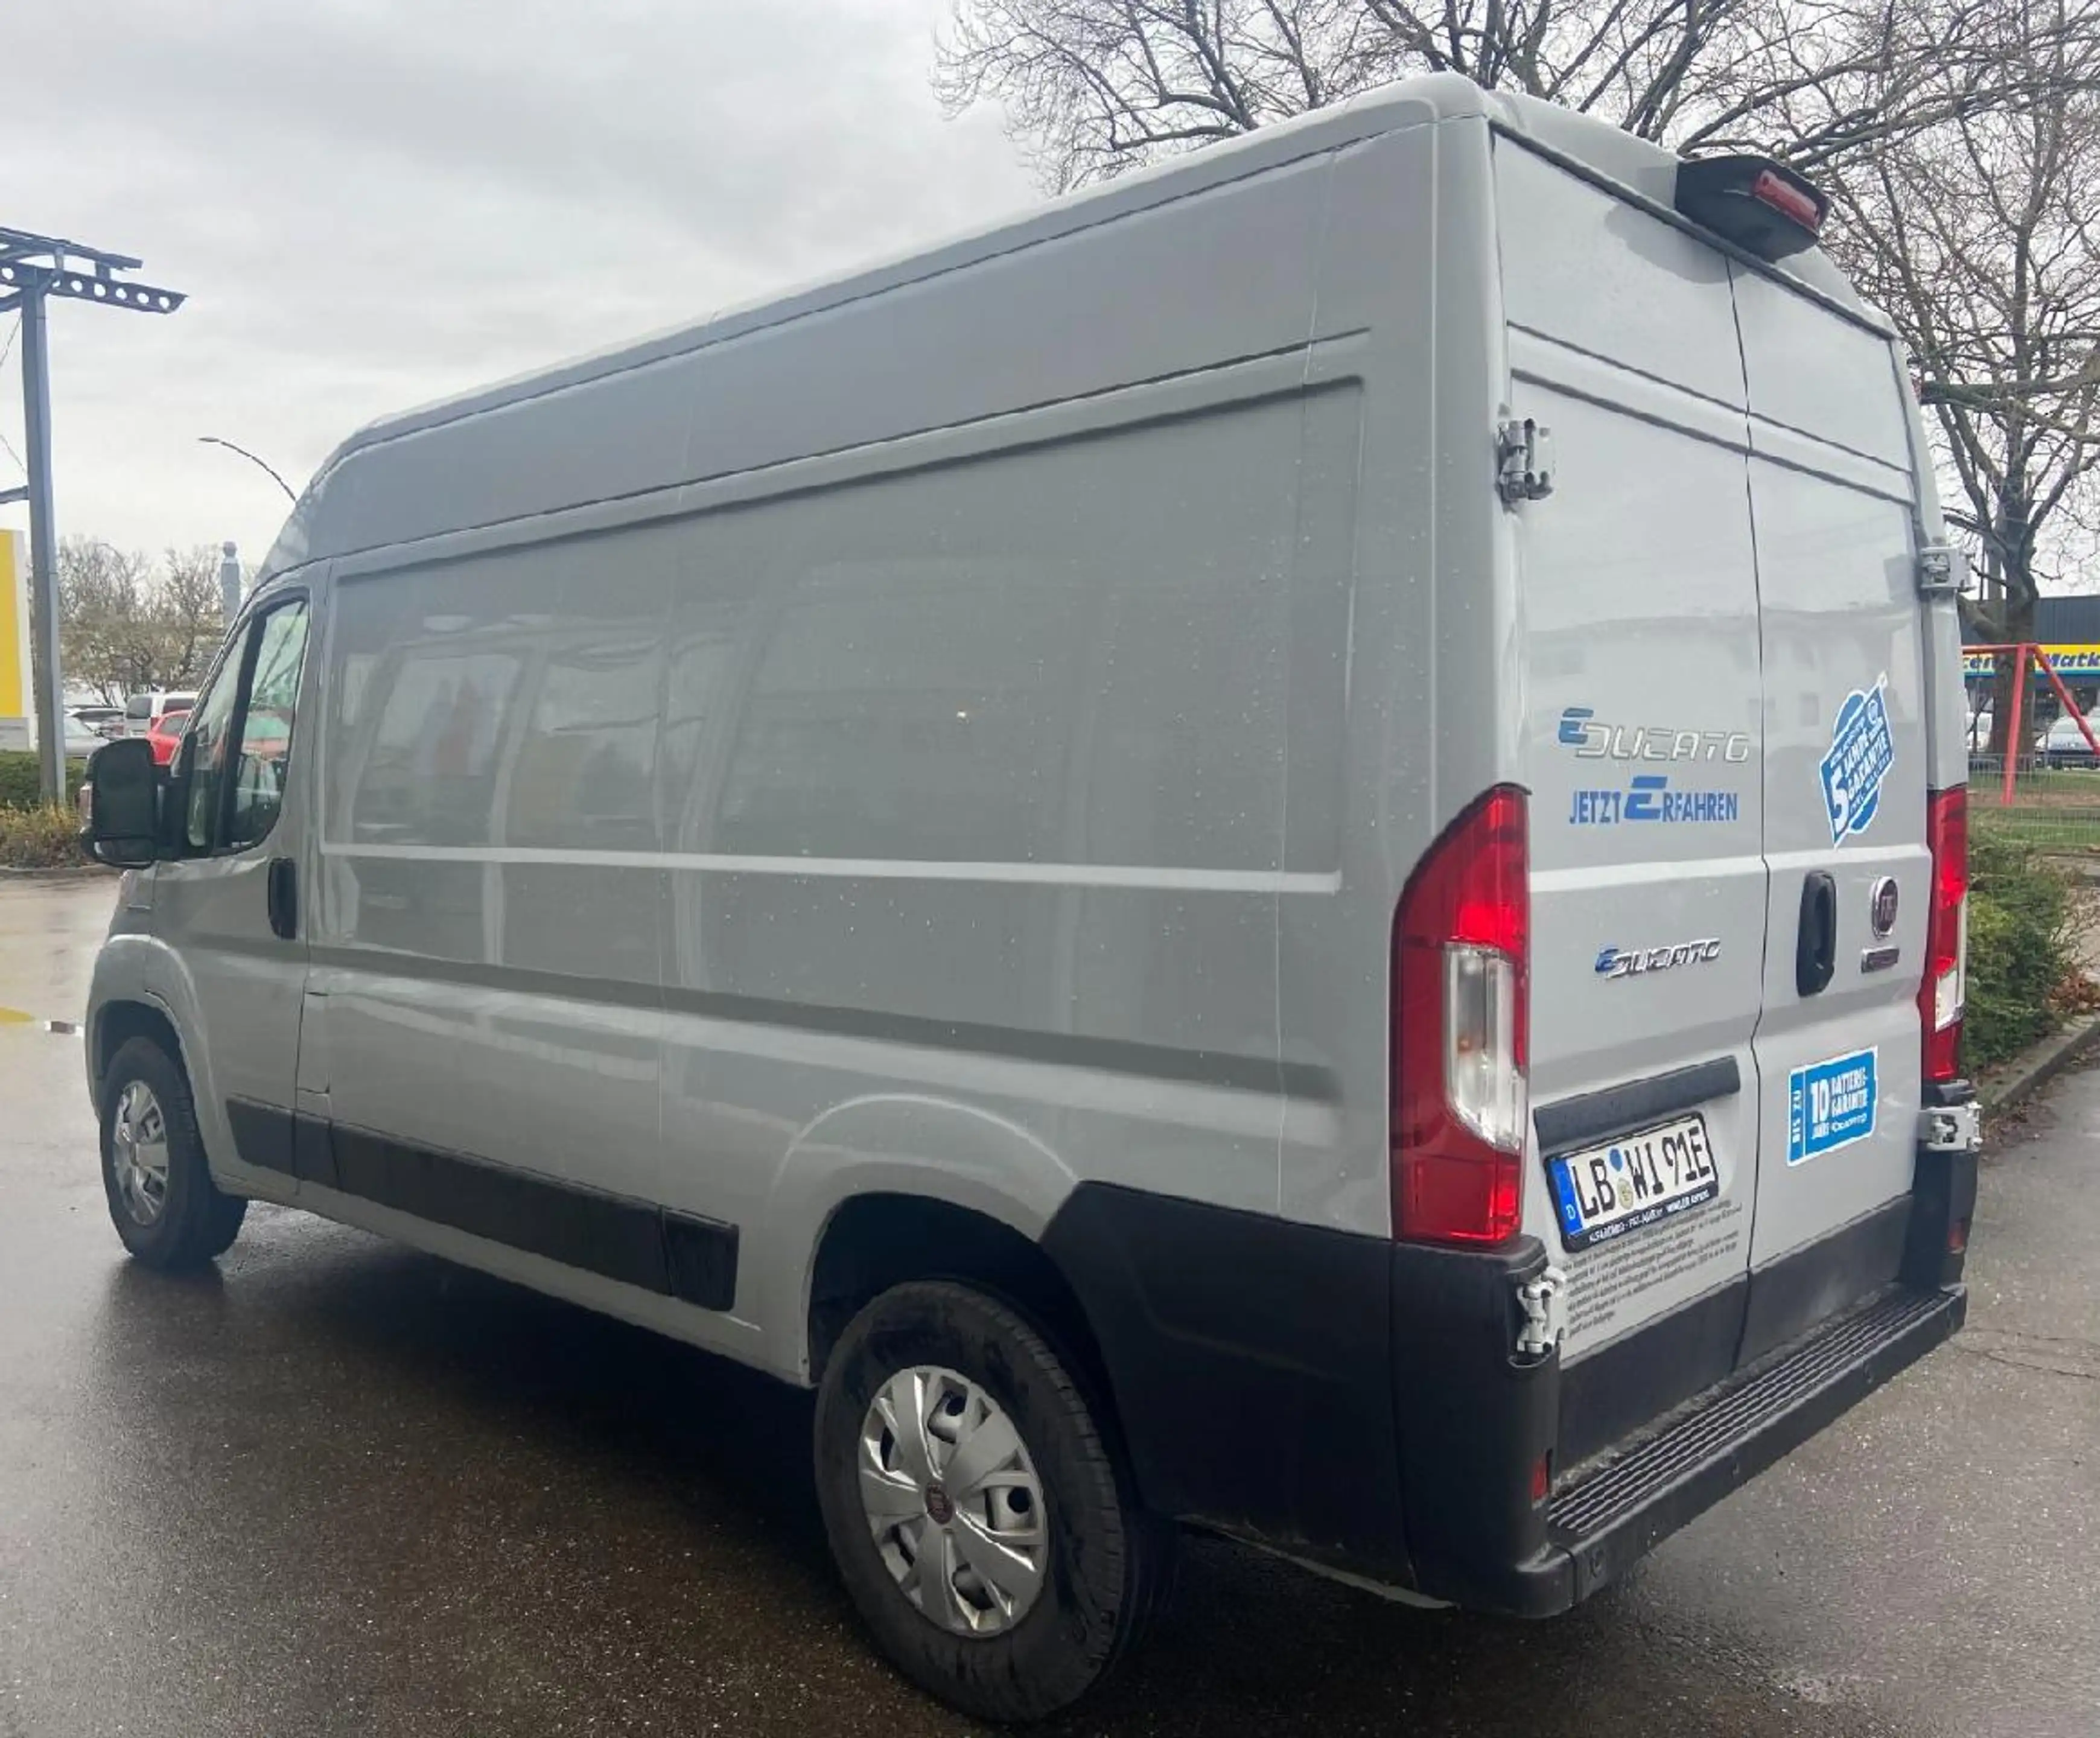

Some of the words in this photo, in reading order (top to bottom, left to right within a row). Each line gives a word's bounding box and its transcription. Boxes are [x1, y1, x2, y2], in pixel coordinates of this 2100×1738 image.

[1570, 791, 1621, 824] JETZT
[1811, 1078, 1830, 1124] 10
[1572, 1157, 1616, 1219] LB
[1624, 1142, 1665, 1200] WI
[1662, 1125, 1711, 1186] 91E
